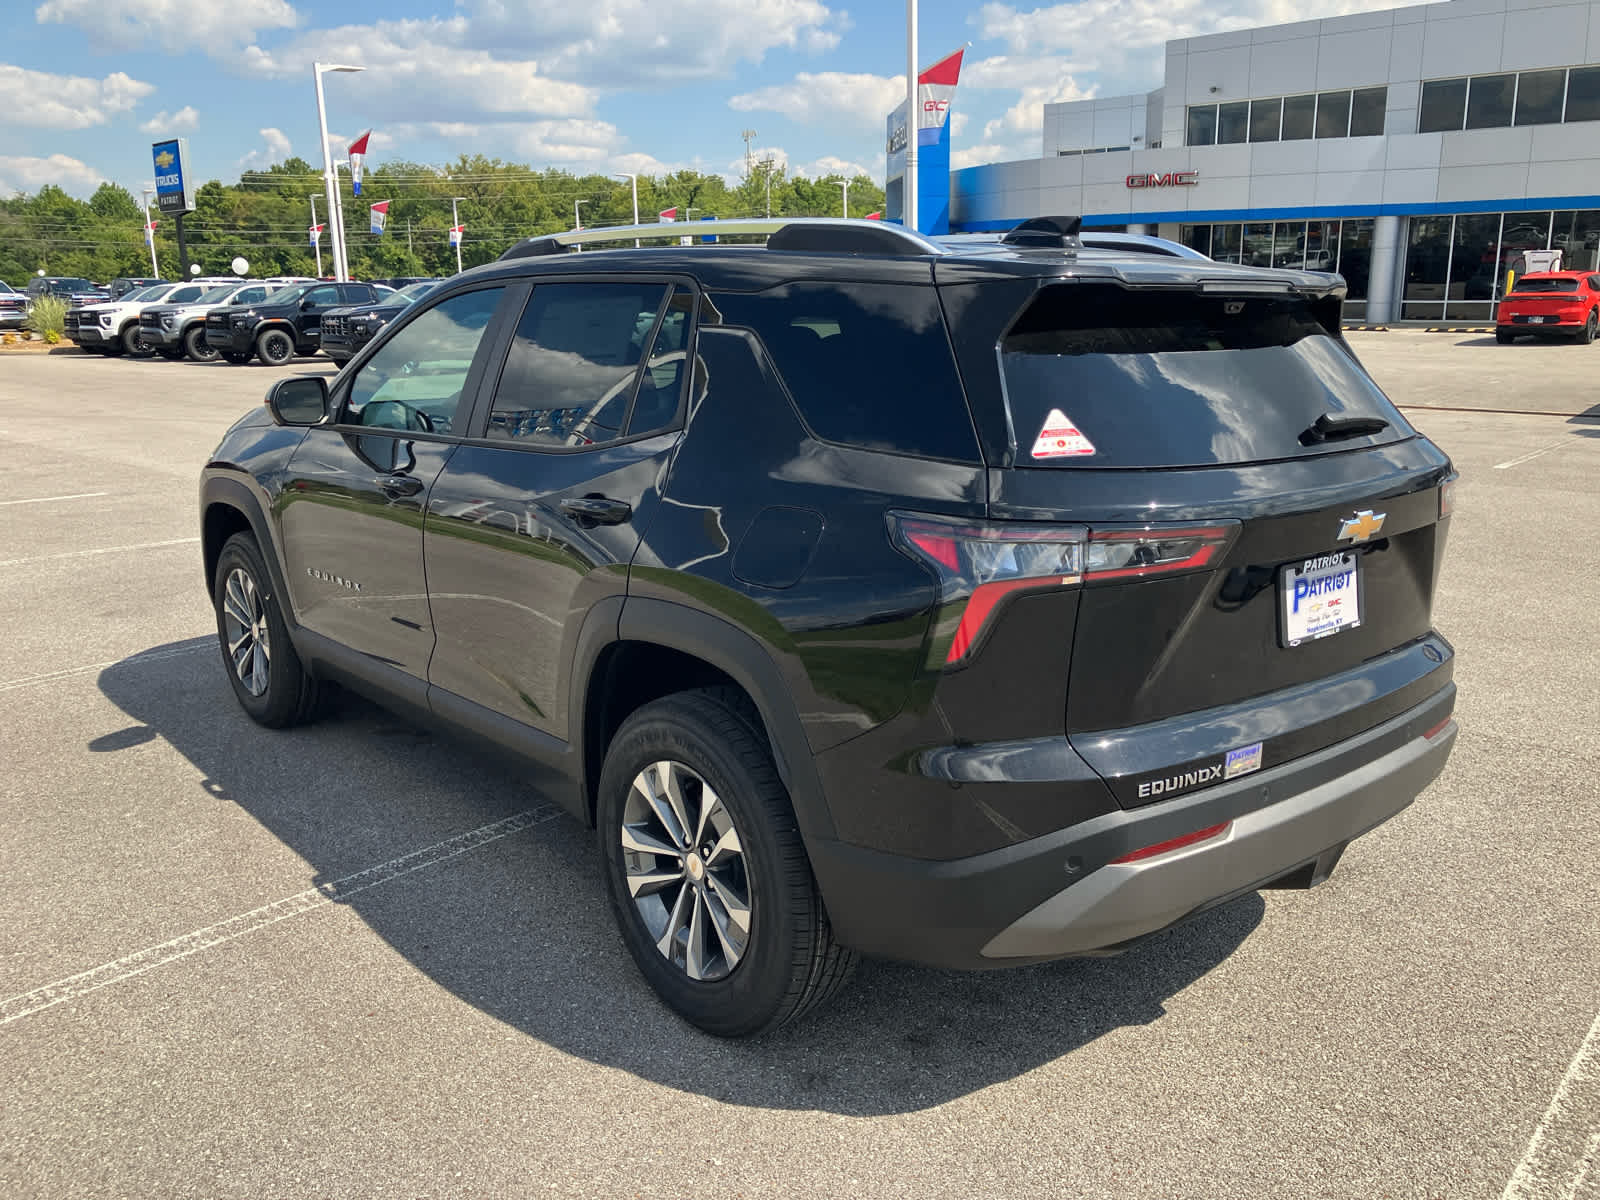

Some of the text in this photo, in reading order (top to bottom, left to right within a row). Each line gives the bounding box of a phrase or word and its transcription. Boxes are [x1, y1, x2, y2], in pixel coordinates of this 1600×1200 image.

[156, 174, 179, 187] TRUCKS
[1126, 171, 1199, 188] GMC
[1303, 552, 1344, 573] PATRIOT
[307, 567, 361, 592] EQUINOX
[1293, 570, 1353, 614] PATRIOT
[1327, 598, 1342, 607] GMC
[1138, 764, 1222, 798] EQUINOX
